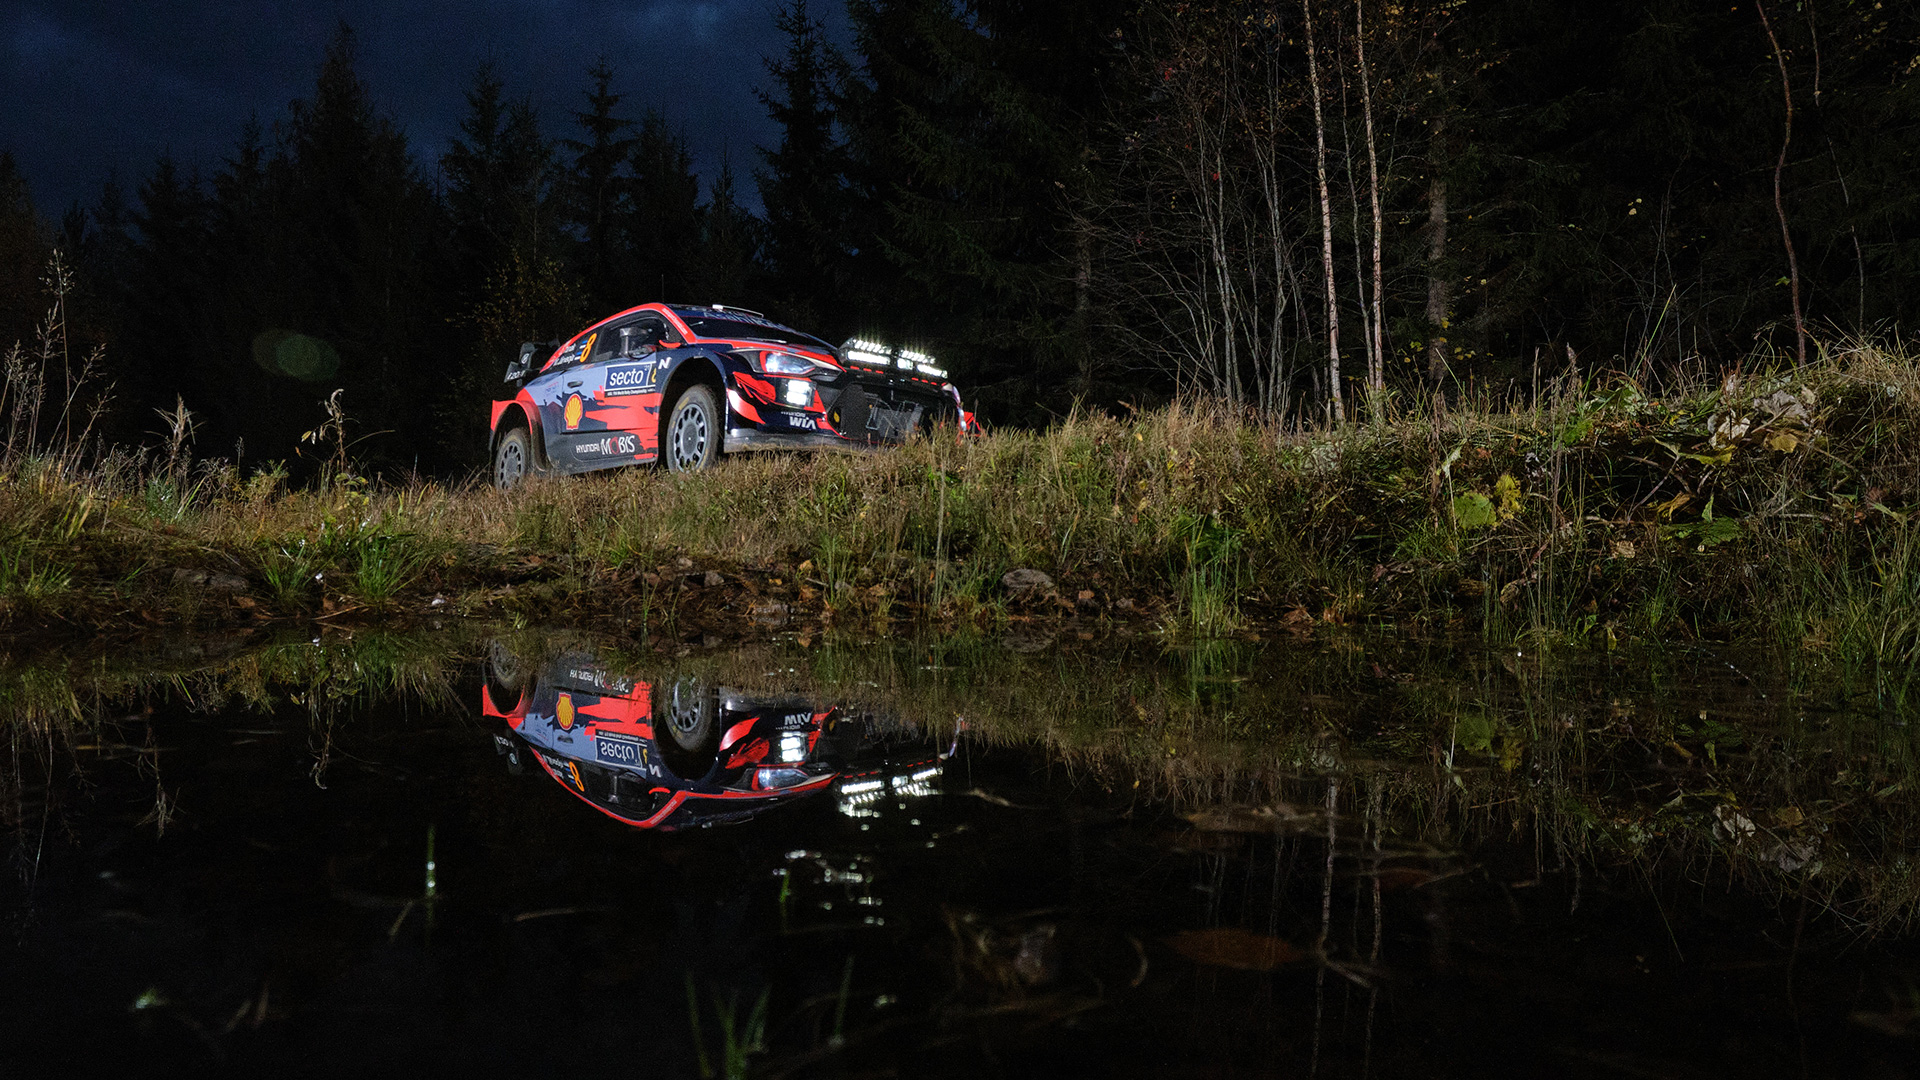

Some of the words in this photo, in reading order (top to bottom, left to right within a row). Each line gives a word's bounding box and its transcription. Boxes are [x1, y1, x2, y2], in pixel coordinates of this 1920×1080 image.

[580, 333, 597, 362] 8
[658, 357, 672, 369] N
[610, 368, 643, 386] secto
[575, 443, 600, 453] HYUNDAI
[601, 435, 635, 455] MOBIS
